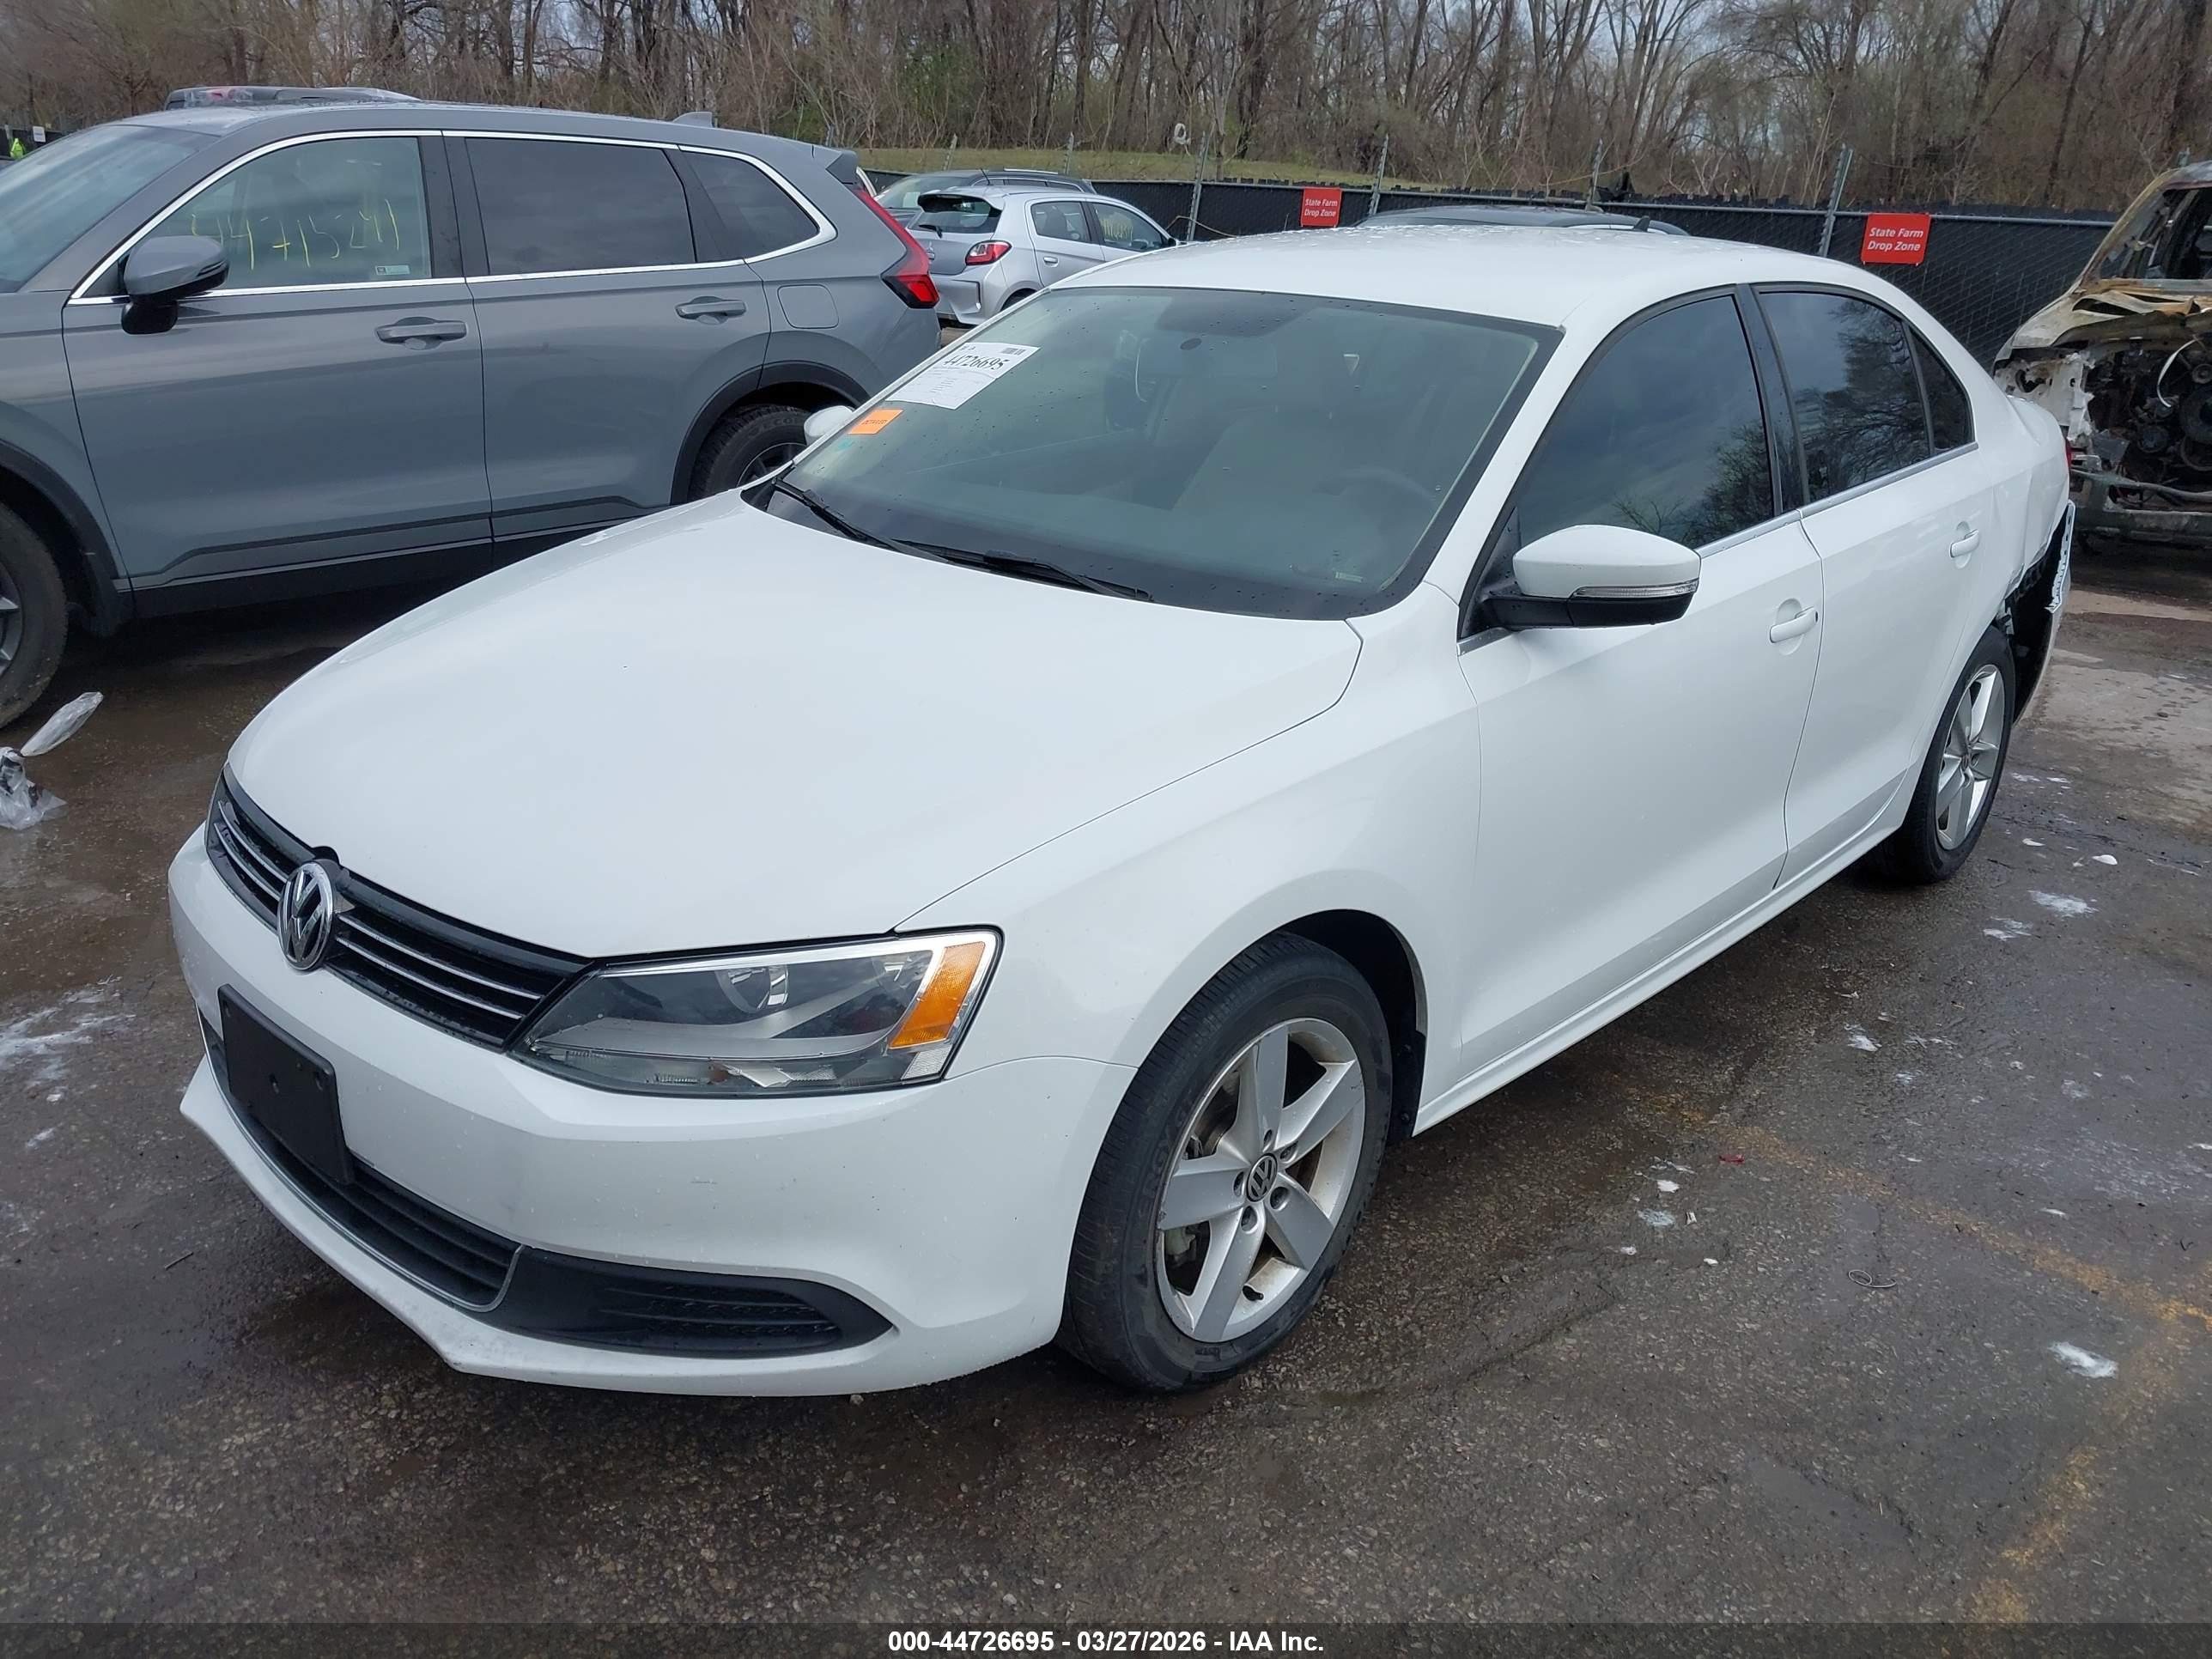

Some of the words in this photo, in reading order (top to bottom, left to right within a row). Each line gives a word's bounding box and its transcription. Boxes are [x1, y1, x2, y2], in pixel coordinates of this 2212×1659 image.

[1304, 209, 1320, 218] Drop
[1321, 209, 1336, 217] Zone
[1869, 228, 1896, 237] State
[1897, 228, 1924, 238] Farm
[1867, 240, 1893, 252] Drop
[1894, 241, 1921, 252] Zone
[943, 354, 1011, 371] 44726695
